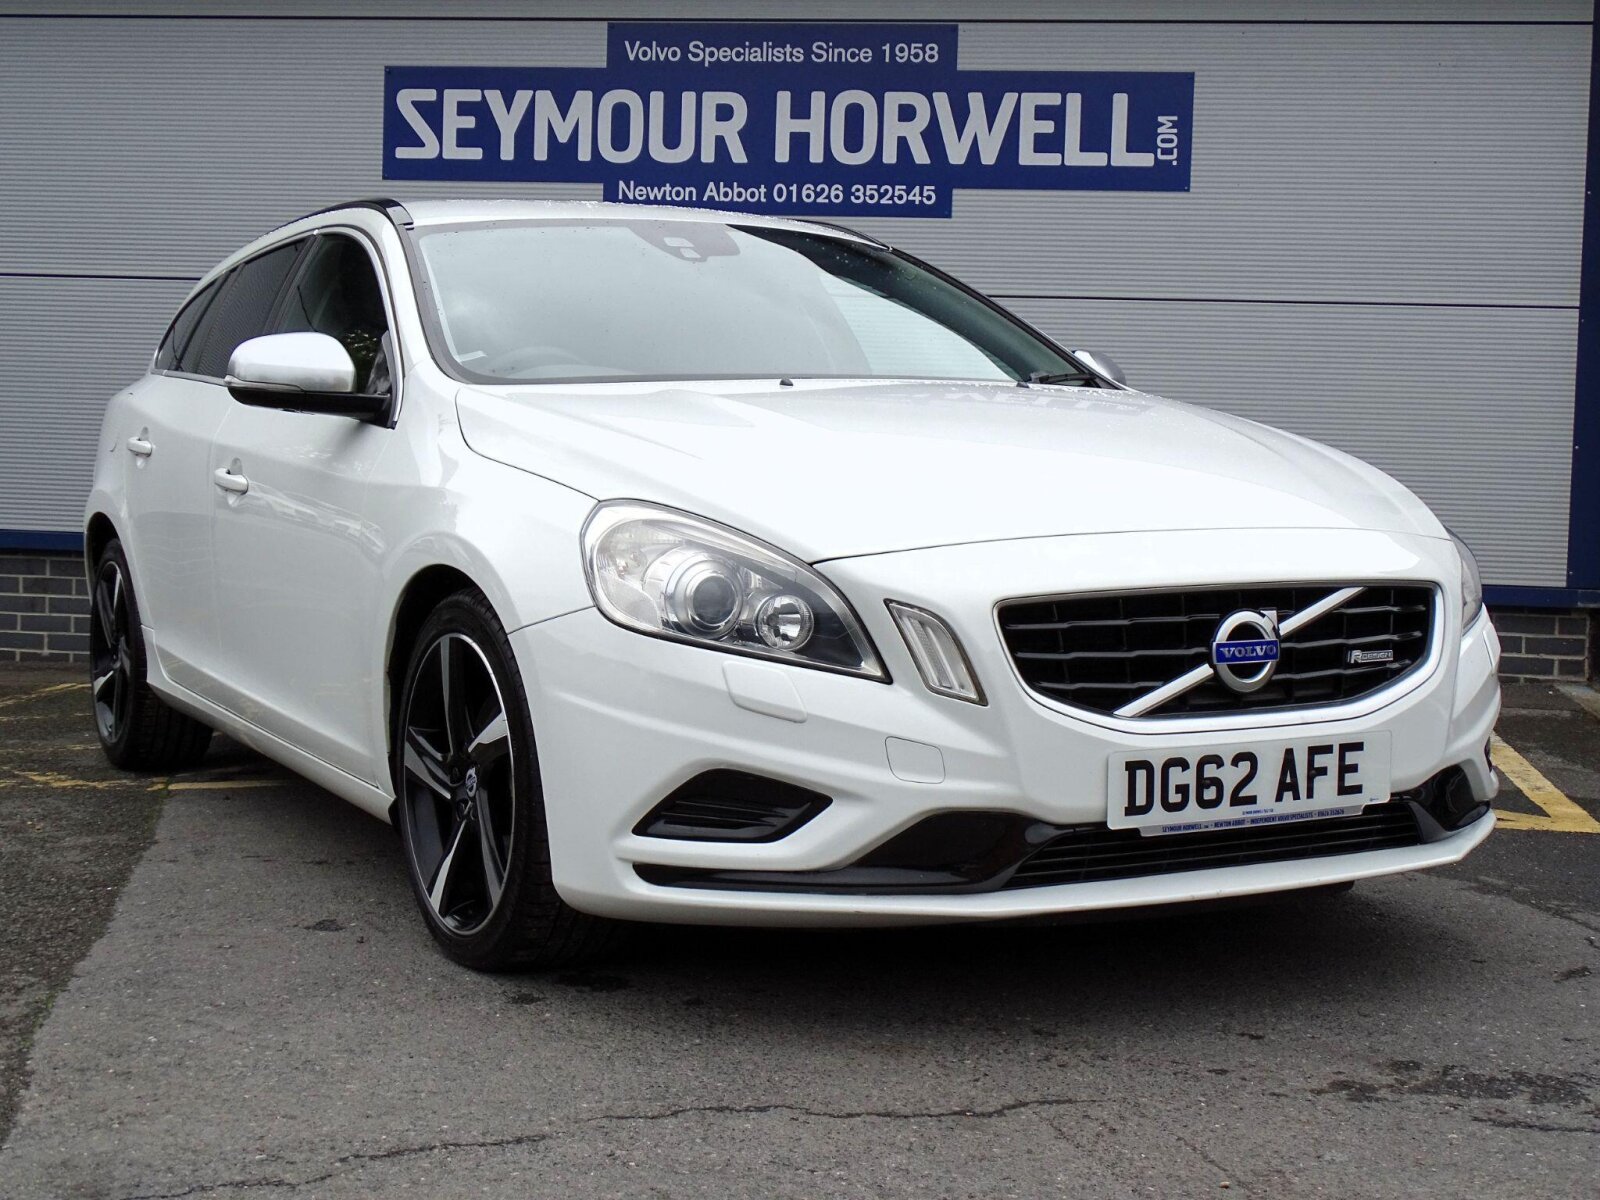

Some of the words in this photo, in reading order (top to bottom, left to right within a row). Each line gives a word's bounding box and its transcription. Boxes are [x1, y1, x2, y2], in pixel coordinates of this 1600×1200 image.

[624, 40, 682, 62] Volvo
[687, 41, 805, 67] Specialists
[811, 41, 873, 63] Since
[881, 43, 940, 64] 1958
[395, 88, 748, 164] SEYMOUR
[774, 89, 1155, 167] HORWELL
[1157, 115, 1178, 166] .COM
[618, 180, 697, 202] Newton
[703, 181, 767, 203] Abbot
[773, 183, 844, 204] 01626
[850, 185, 936, 205] 352545
[1219, 643, 1277, 659] VOLVO
[1124, 750, 1259, 817] DG62
[1274, 741, 1365, 803] AFE
